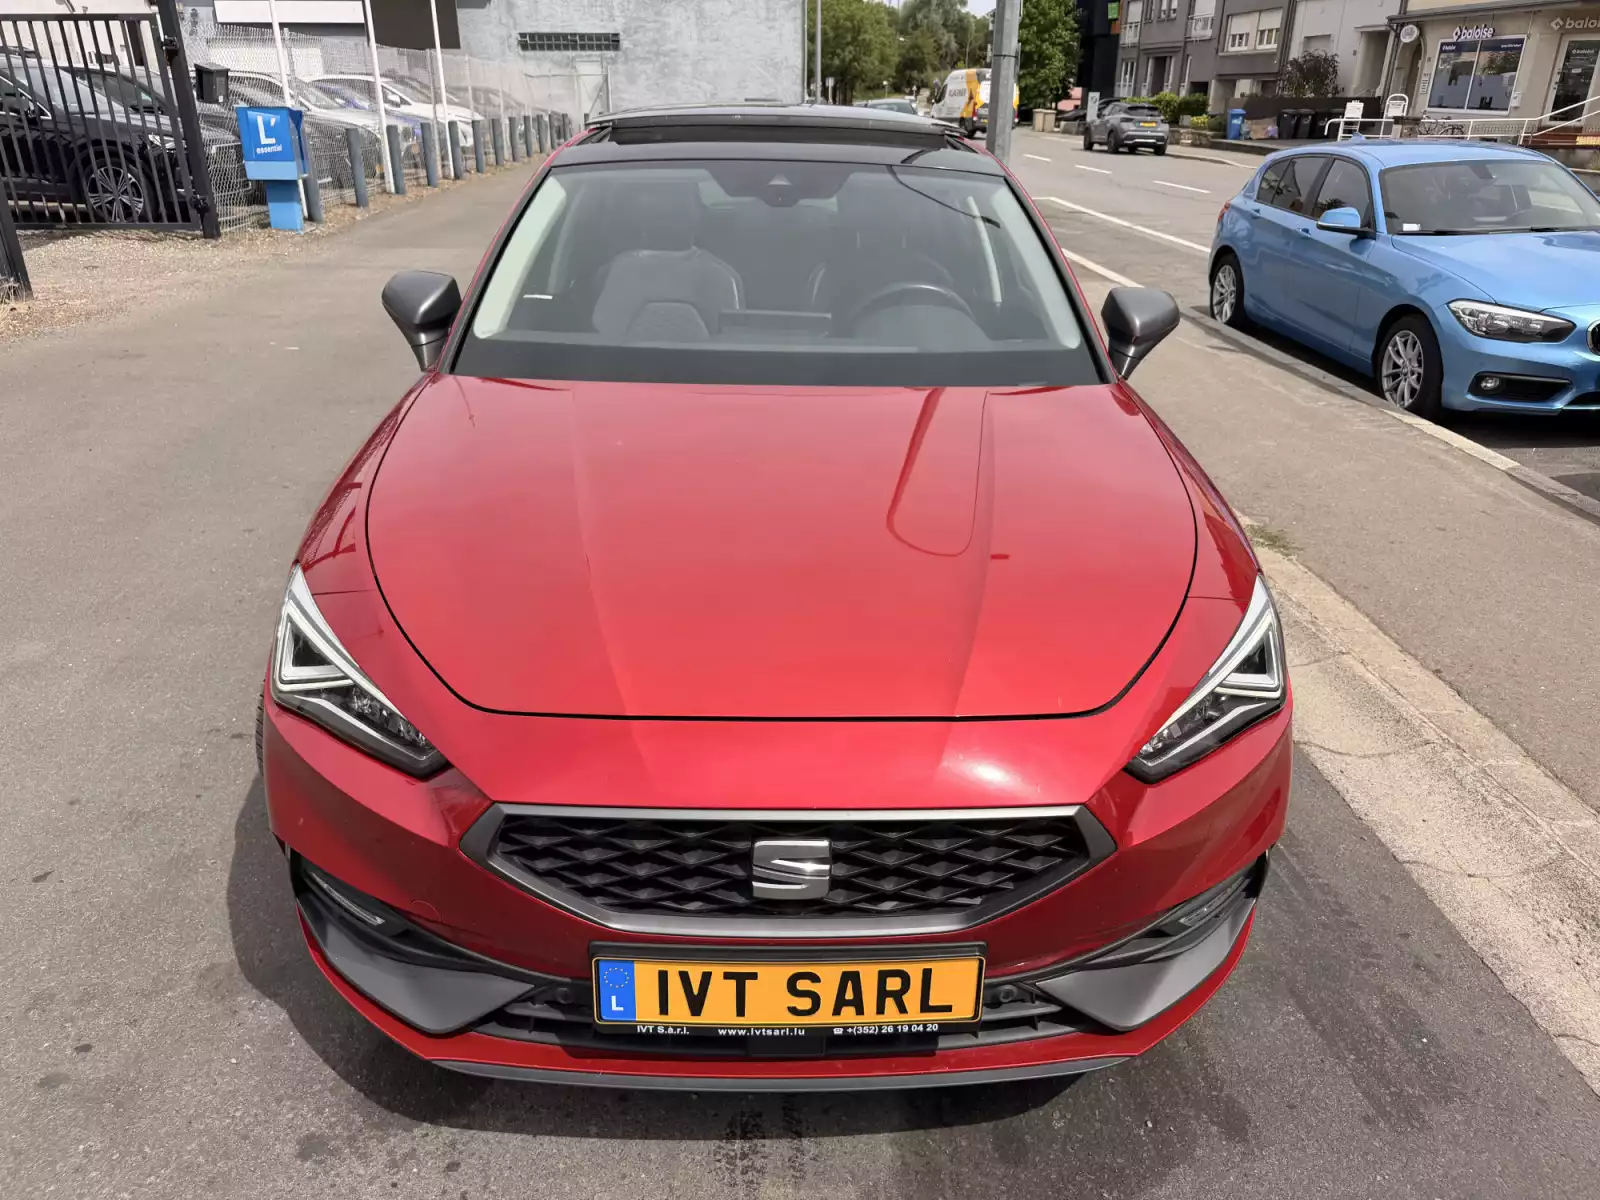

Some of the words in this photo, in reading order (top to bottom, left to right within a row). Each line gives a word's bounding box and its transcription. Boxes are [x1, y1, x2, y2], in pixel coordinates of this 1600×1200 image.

[1460, 23, 1495, 40] baloise
[657, 969, 759, 1018] IVT
[786, 967, 953, 1017] SARL
[610, 995, 625, 1011] L
[636, 1024, 654, 1034] IVT
[717, 1026, 805, 1037] www.ivtsarl.lu
[846, 1025, 878, 1036] +(352)
[881, 1025, 894, 1033] 26
[897, 1024, 909, 1033] 19
[911, 1024, 924, 1033] 04
[926, 1023, 939, 1032] 20
